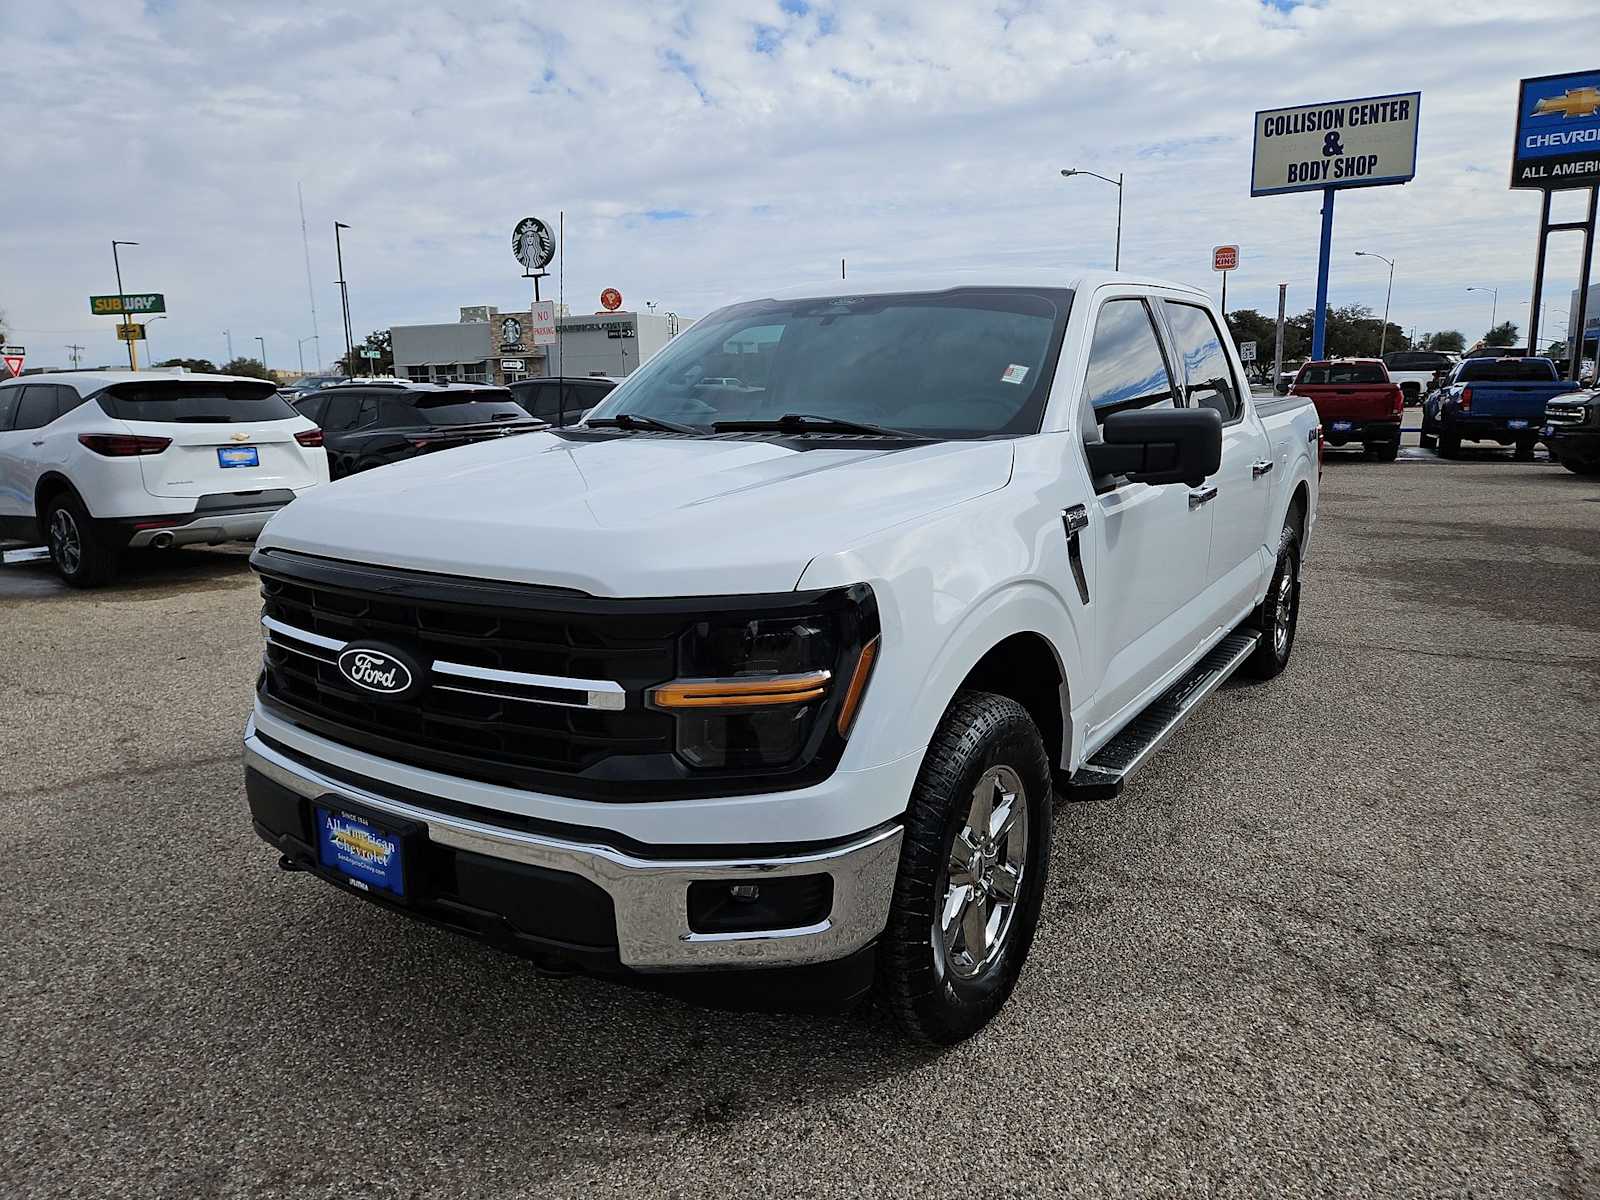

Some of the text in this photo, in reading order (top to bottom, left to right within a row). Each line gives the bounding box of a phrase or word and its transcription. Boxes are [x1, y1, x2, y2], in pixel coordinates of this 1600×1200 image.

[1264, 100, 1410, 138] COLLISION CENTER
[1322, 131, 1344, 157] &
[1525, 128, 1600, 149] CHEVRO
[1287, 154, 1378, 184] BODY SHOP
[1521, 160, 1600, 179] ALL AMERI
[1215, 258, 1236, 266] KING
[95, 296, 154, 311] SUBWAY
[537, 311, 549, 321] NO
[533, 326, 555, 336] PARKING
[351, 653, 397, 688] Ford
[341, 810, 358, 822] SINCE
[326, 817, 395, 853] All American
[335, 836, 389, 867] Chevrolet
